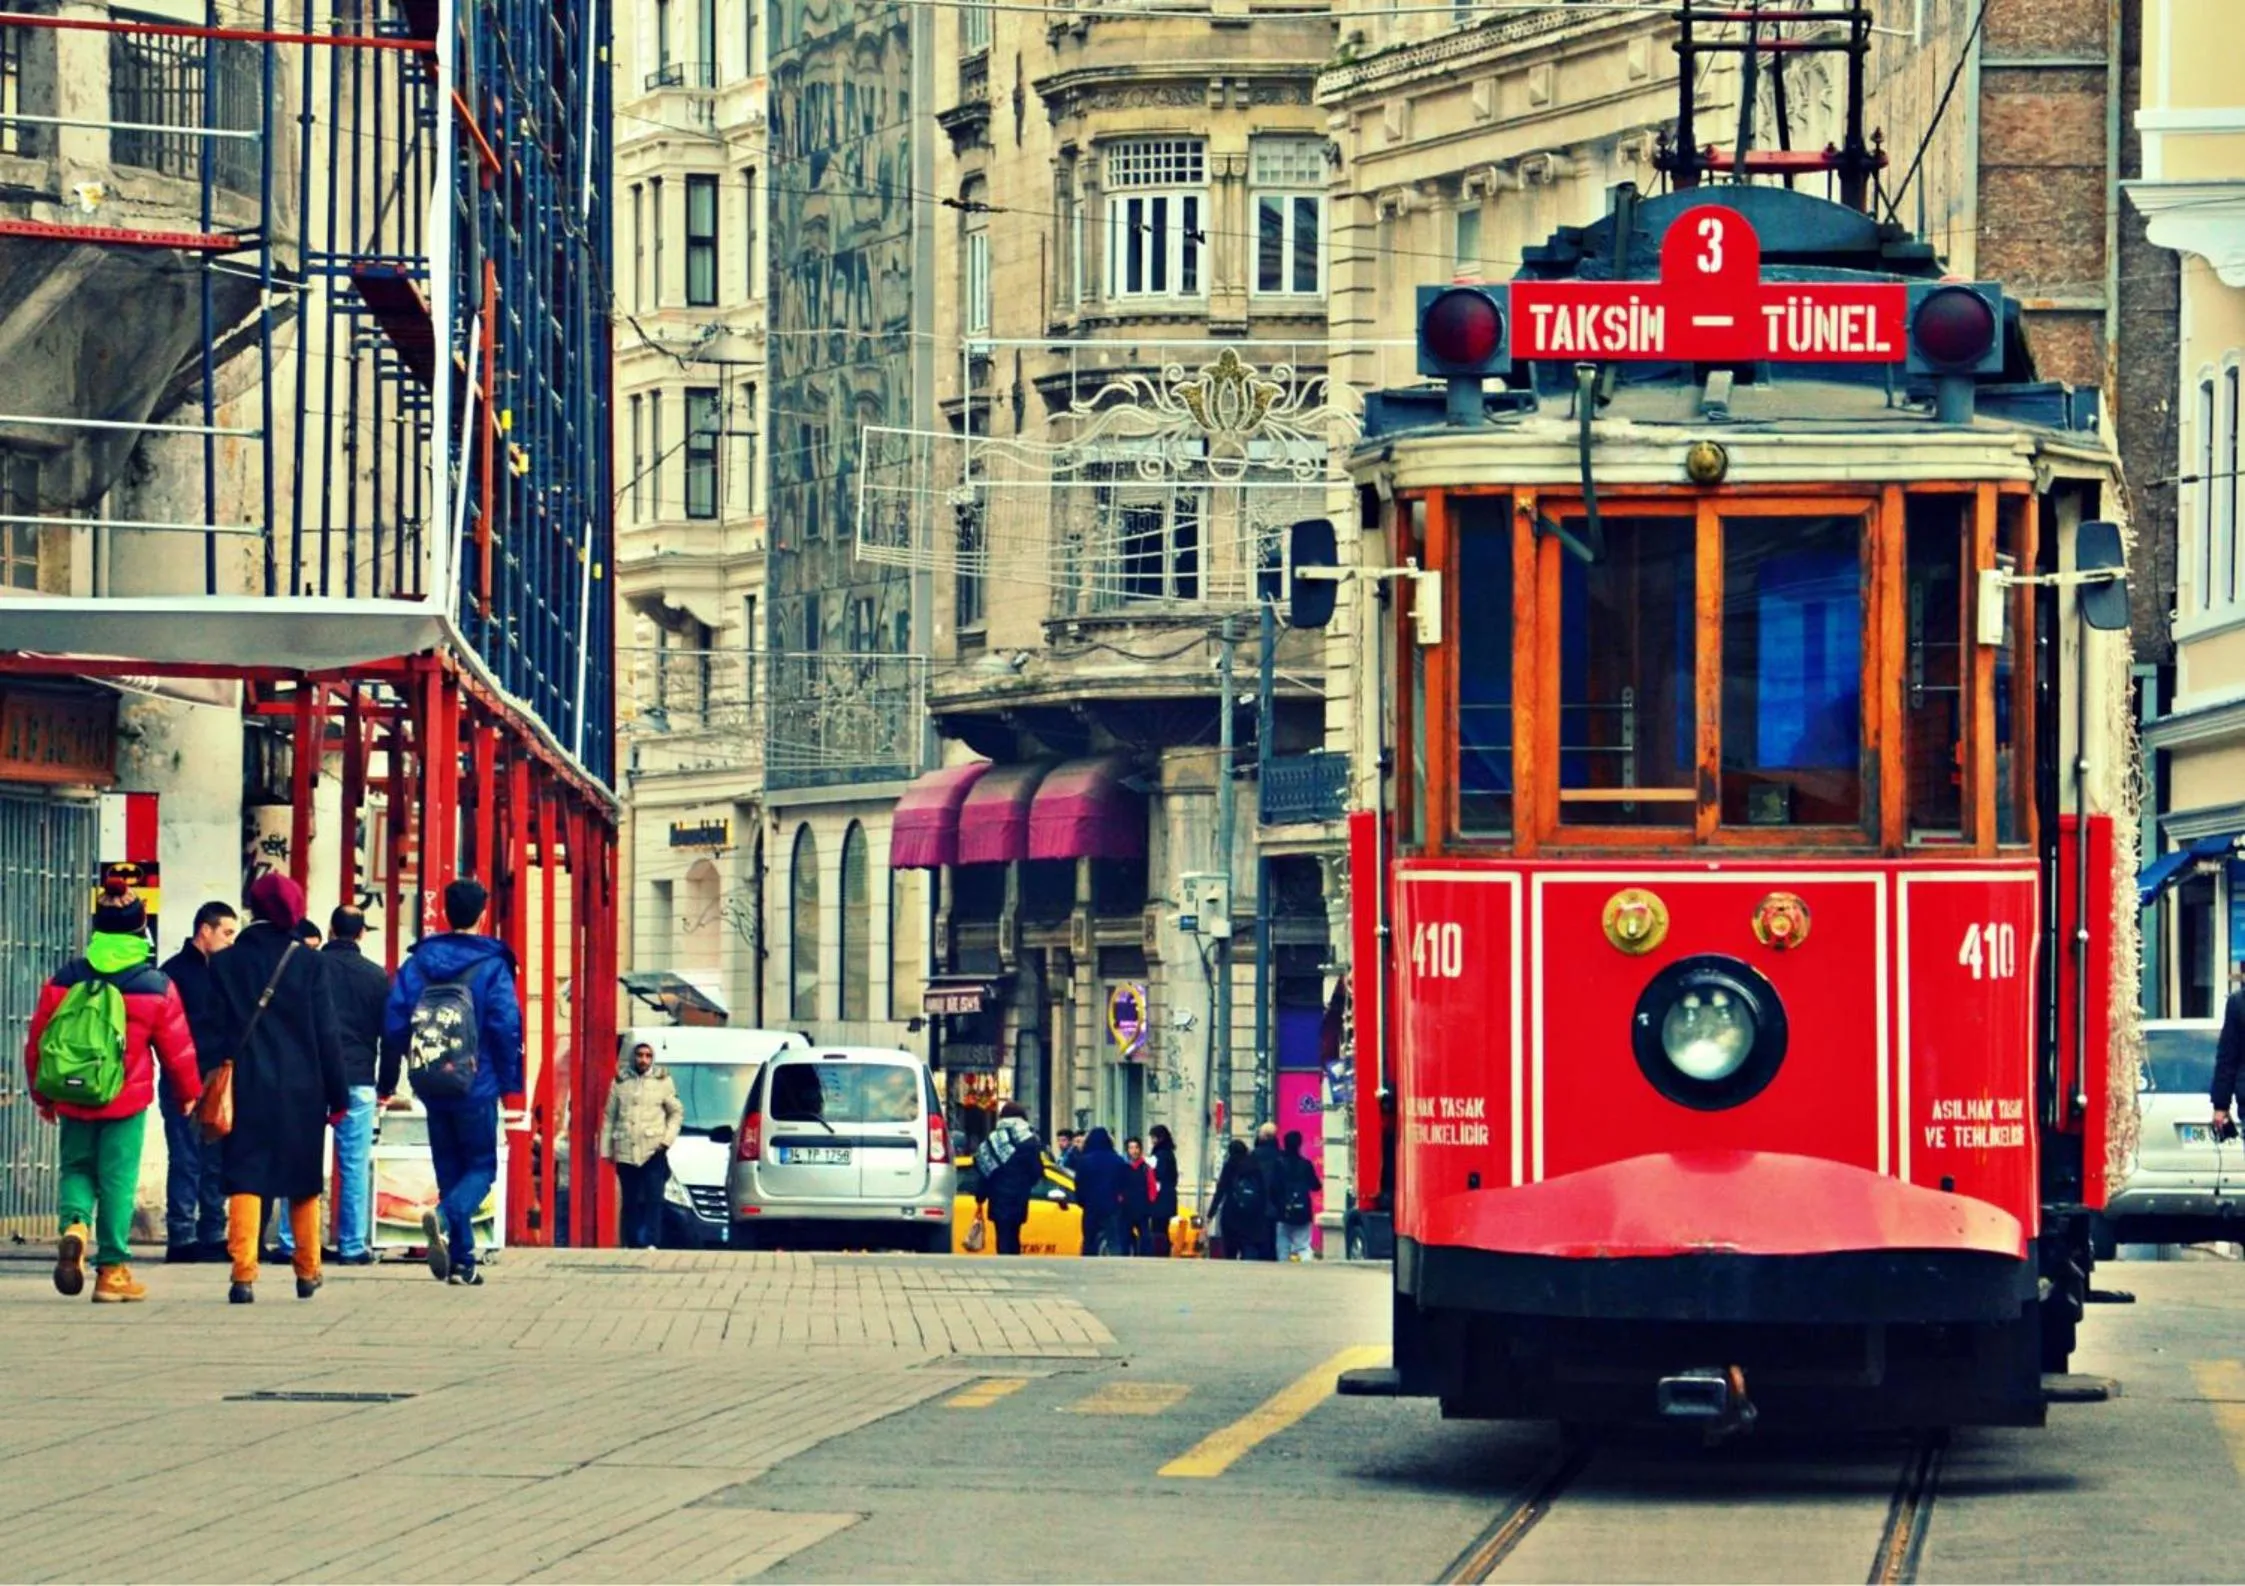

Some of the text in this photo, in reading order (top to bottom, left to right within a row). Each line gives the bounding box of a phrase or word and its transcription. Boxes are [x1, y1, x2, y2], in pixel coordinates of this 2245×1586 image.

[1696, 218, 1724, 274] 3
[1529, 295, 1665, 353] TAKSİM
[1761, 296, 1892, 353] TÜNEL
[1412, 921, 1463, 978] 410
[1958, 921, 2015, 980] 410
[1440, 1096, 1485, 1119] YASAK
[1924, 1125, 1947, 1148] VE
